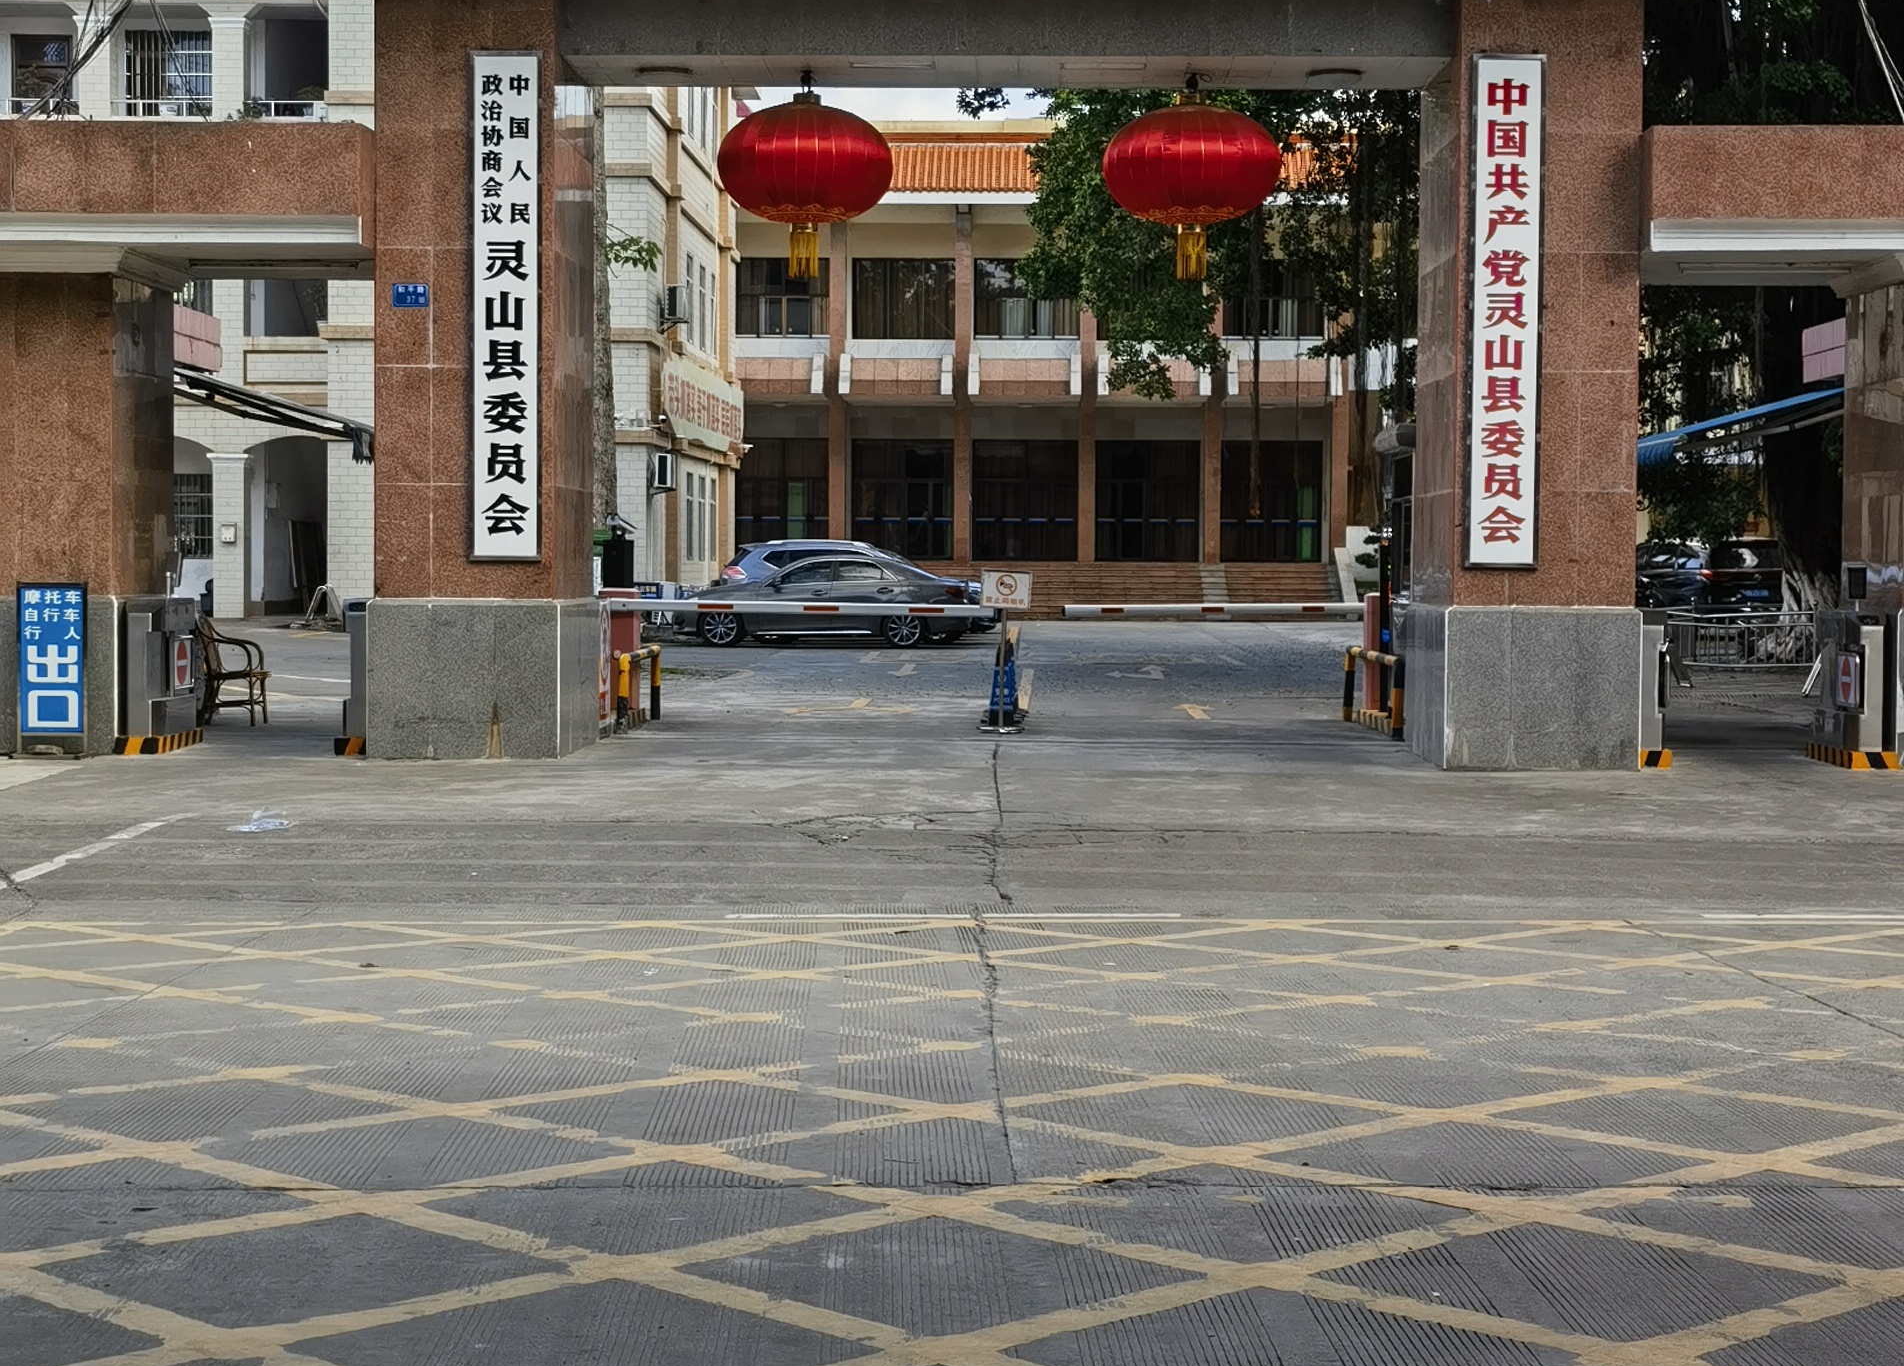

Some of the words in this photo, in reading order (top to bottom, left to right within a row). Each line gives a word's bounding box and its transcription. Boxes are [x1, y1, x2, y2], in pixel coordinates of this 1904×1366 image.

[481, 74, 504, 225] 政治协商会议
[509, 74, 532, 225] 中国人民
[1478, 78, 1531, 545] 中国共产党灵山县委员会
[481, 239, 531, 537] 灵山县委员会
[24, 590, 82, 605] 摩托车
[24, 608, 81, 623] 自行车
[27, 644, 79, 728] 出口
